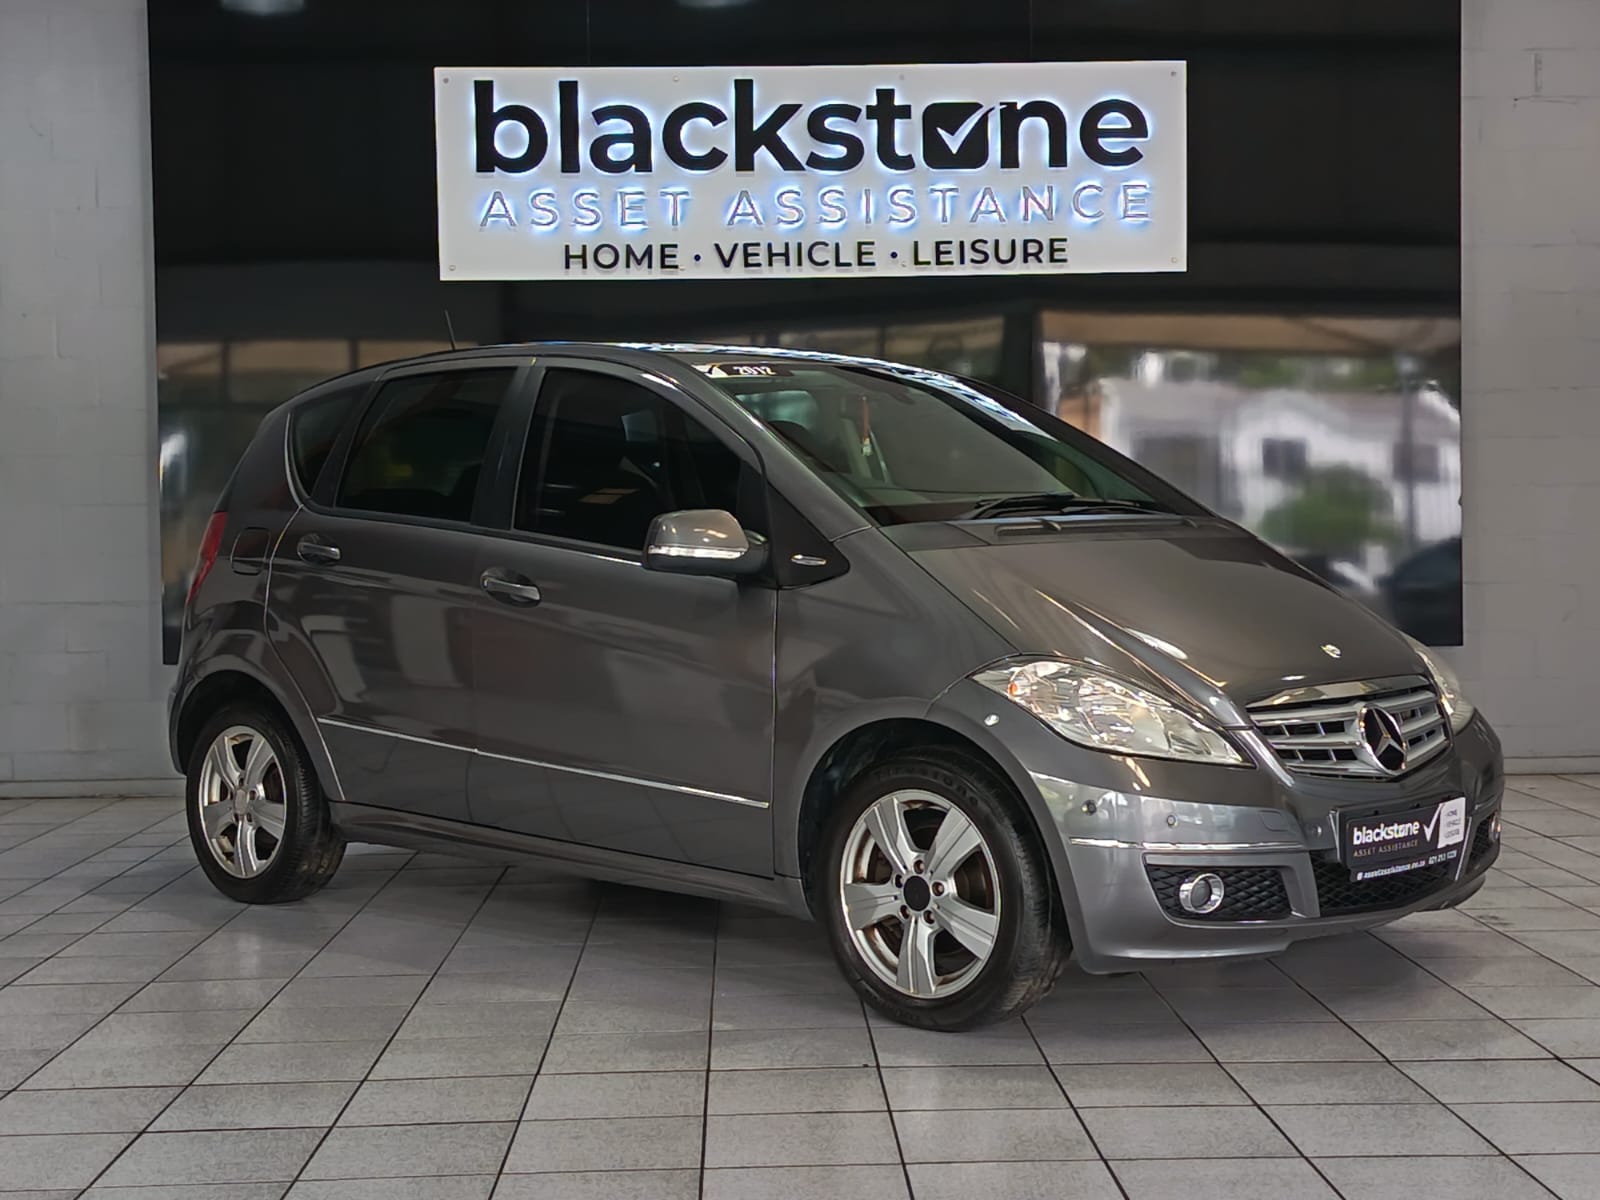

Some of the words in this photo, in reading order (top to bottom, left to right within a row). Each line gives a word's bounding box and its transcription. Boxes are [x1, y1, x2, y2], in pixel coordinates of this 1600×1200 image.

[479, 188, 690, 227] ASSET
[727, 184, 1149, 226] ASSISTANCE
[564, 243, 679, 270] HOME
[713, 241, 876, 268] VEHICLE
[913, 237, 1068, 266] LEISURE
[733, 365, 777, 376] 2012
[1353, 821, 1420, 845] blackstone
[1353, 846, 1376, 858] ASSET
[1378, 840, 1419, 853] ASSISTANCE
